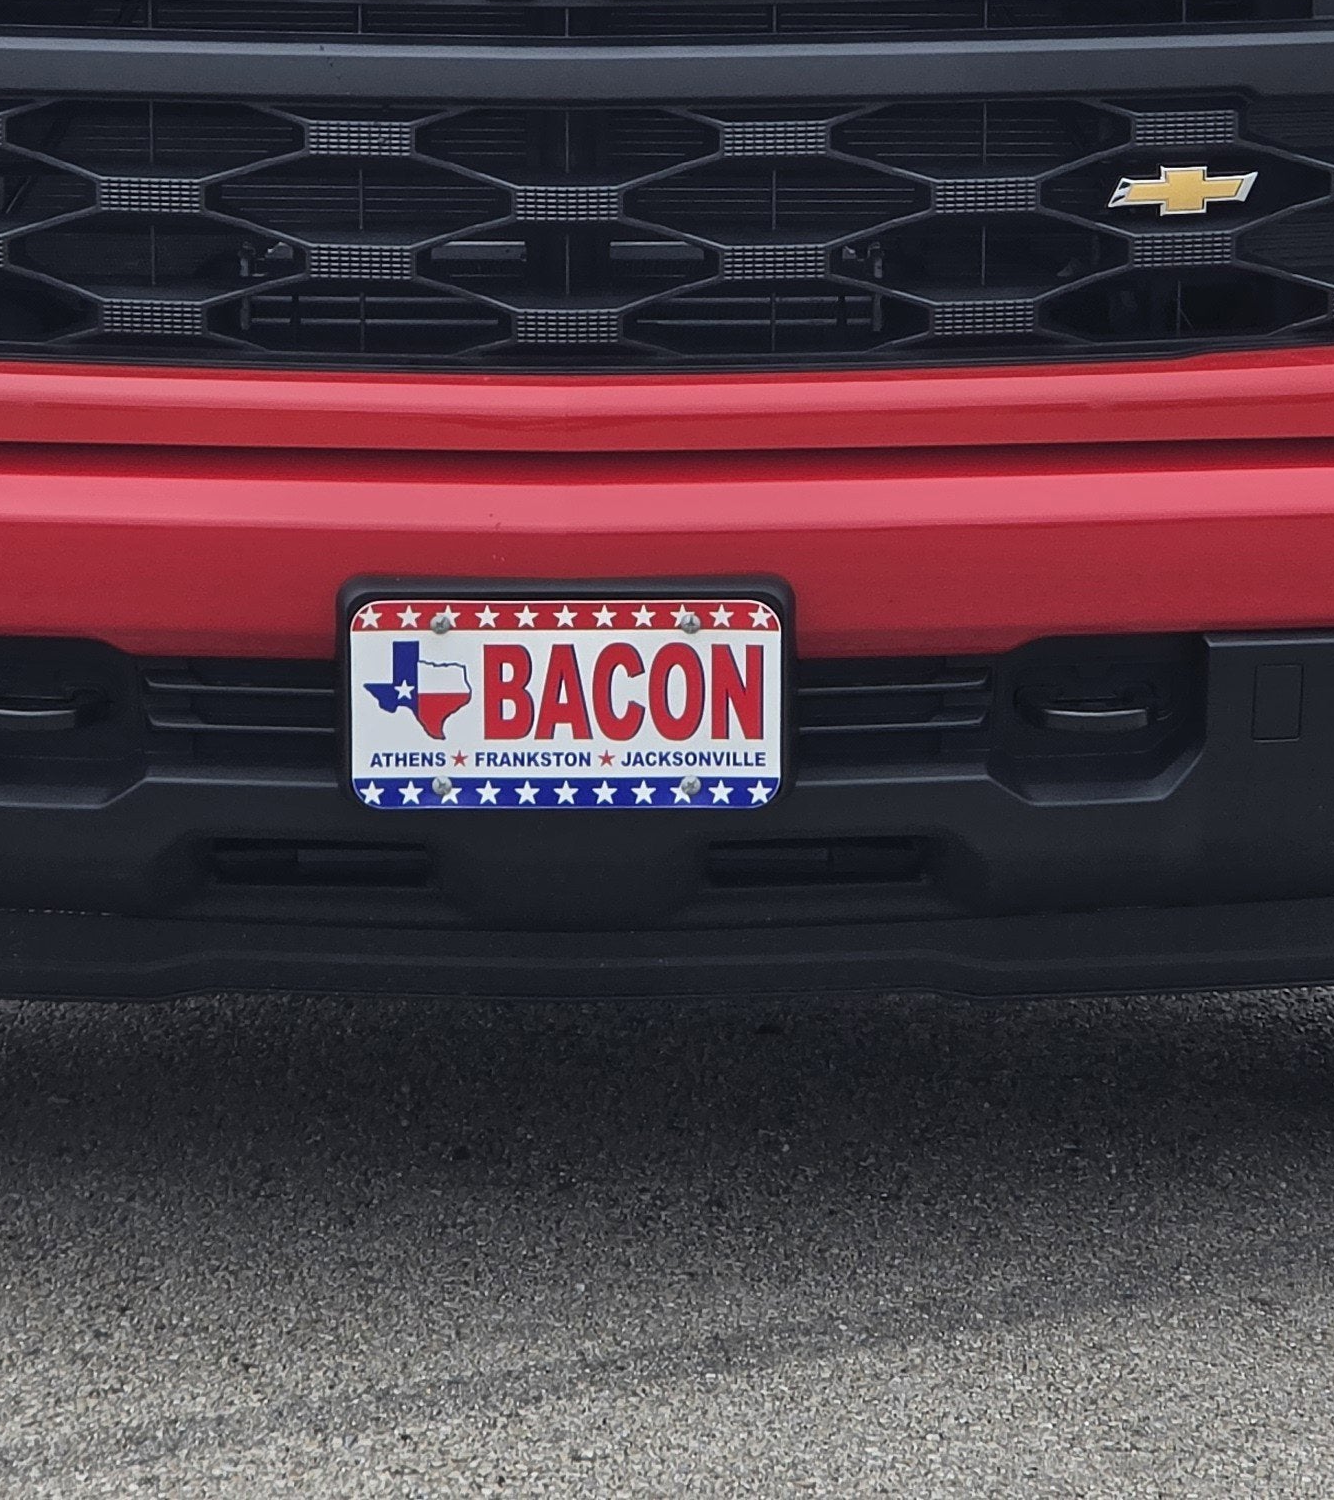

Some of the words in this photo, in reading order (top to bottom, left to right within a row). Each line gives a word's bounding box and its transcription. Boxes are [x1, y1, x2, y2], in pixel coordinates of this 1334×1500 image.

[483, 642, 764, 741] BACON
[369, 751, 447, 768] ATHENS
[474, 751, 592, 768] FRANKSTON
[620, 751, 767, 768] JACKSONVILLE
